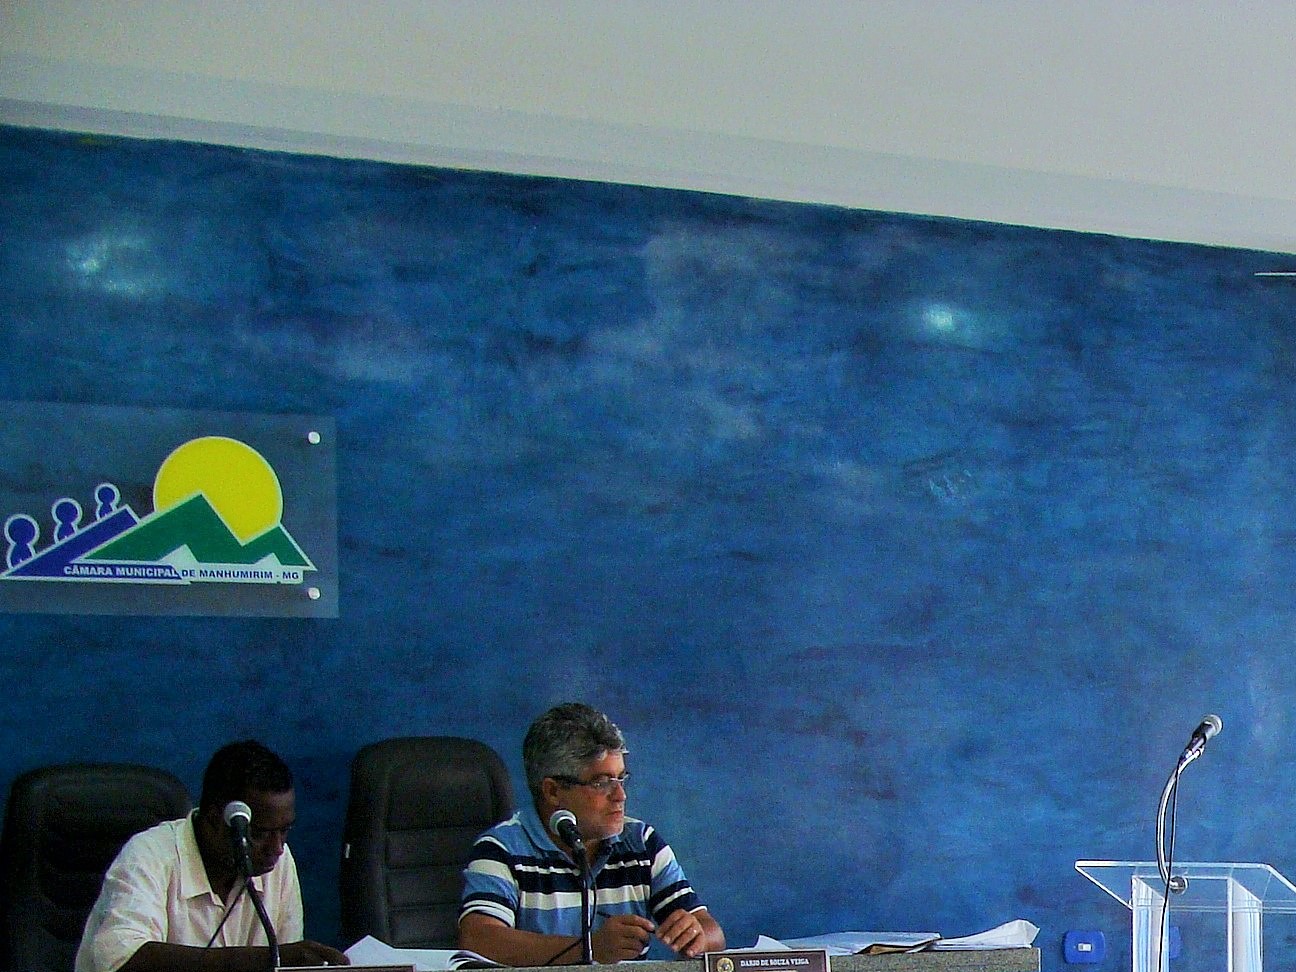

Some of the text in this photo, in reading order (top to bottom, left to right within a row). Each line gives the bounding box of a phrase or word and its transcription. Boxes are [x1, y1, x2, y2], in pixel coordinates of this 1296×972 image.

[63, 564, 113, 576] CÂMARA
[116, 565, 179, 578] MUNICIPAL
[181, 569, 196, 578] DE
[199, 569, 273, 579] MANHUMIRIM
[282, 571, 299, 580] MG
